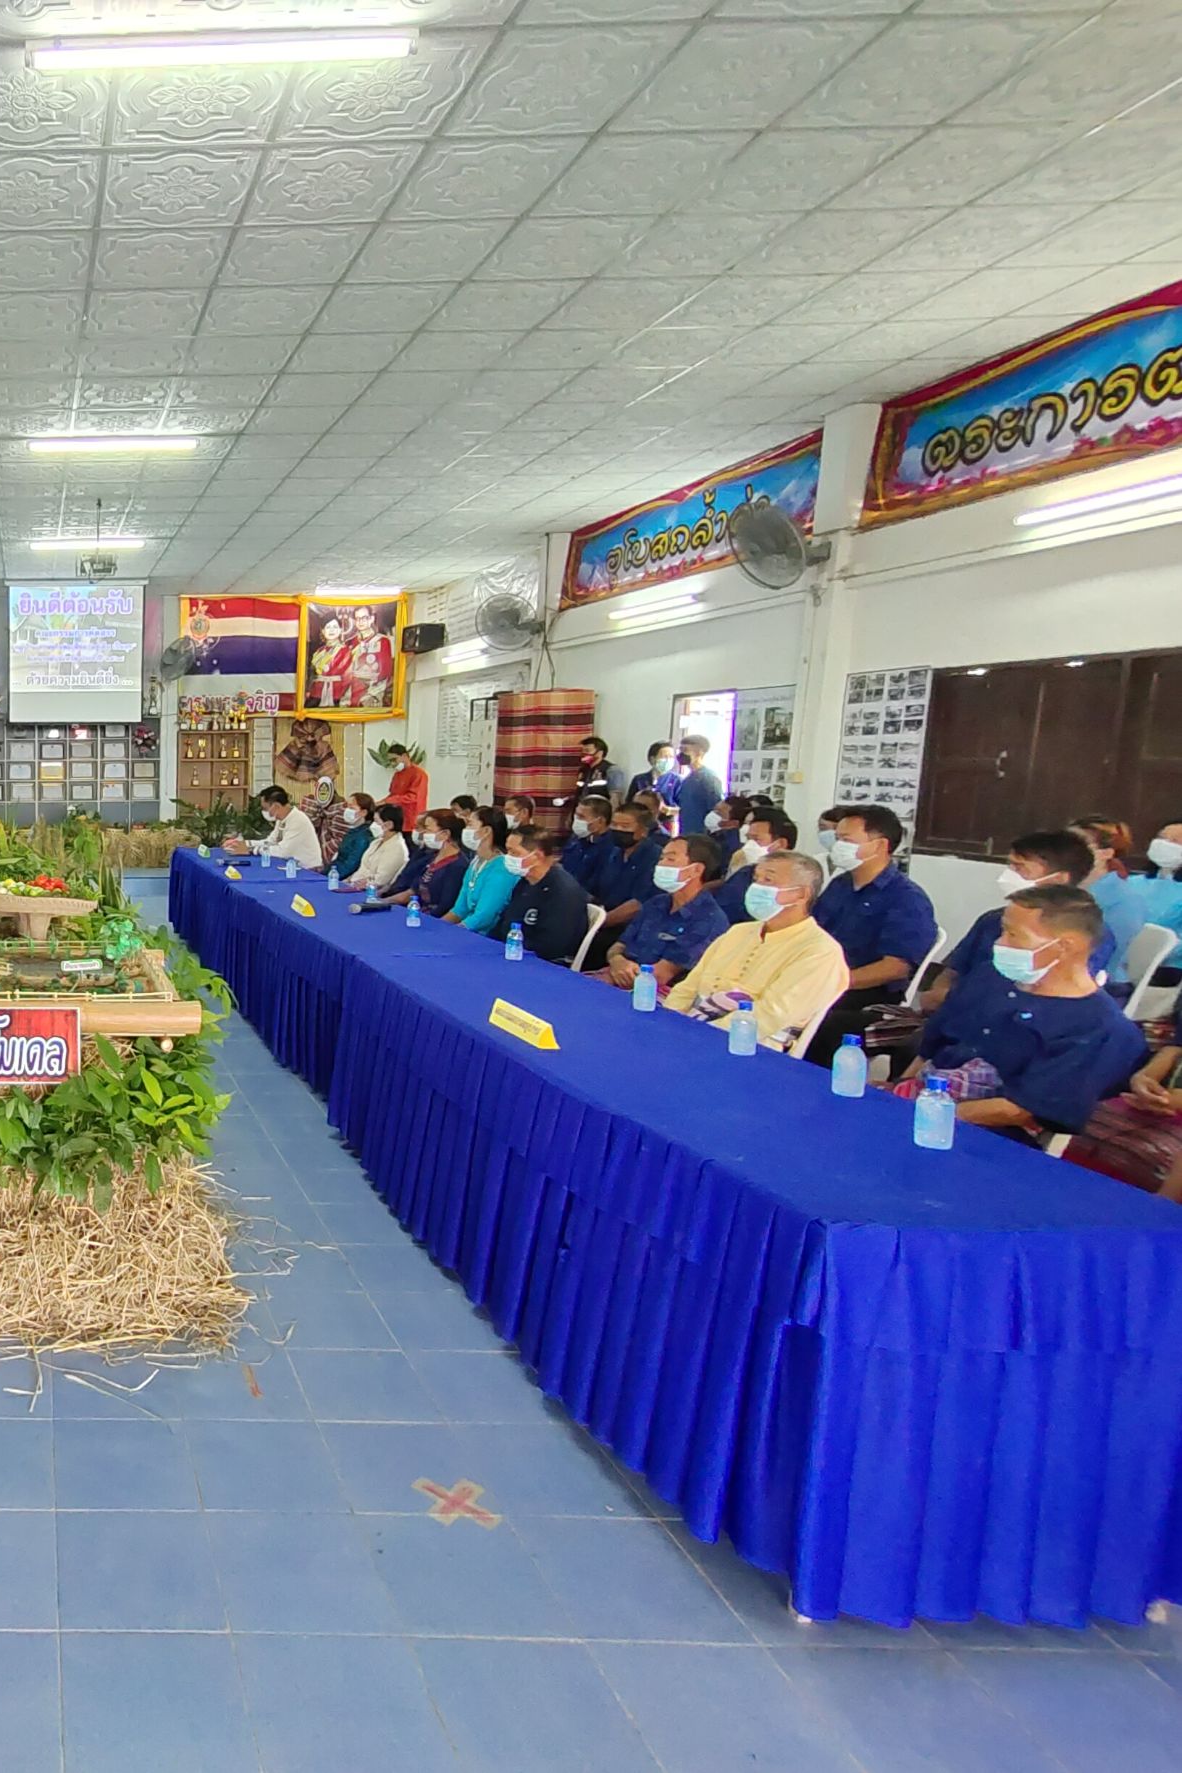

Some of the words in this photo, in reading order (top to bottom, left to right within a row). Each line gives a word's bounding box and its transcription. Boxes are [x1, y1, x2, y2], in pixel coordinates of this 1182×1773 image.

[18, 589, 134, 615] ยินดีต้อนรับ
